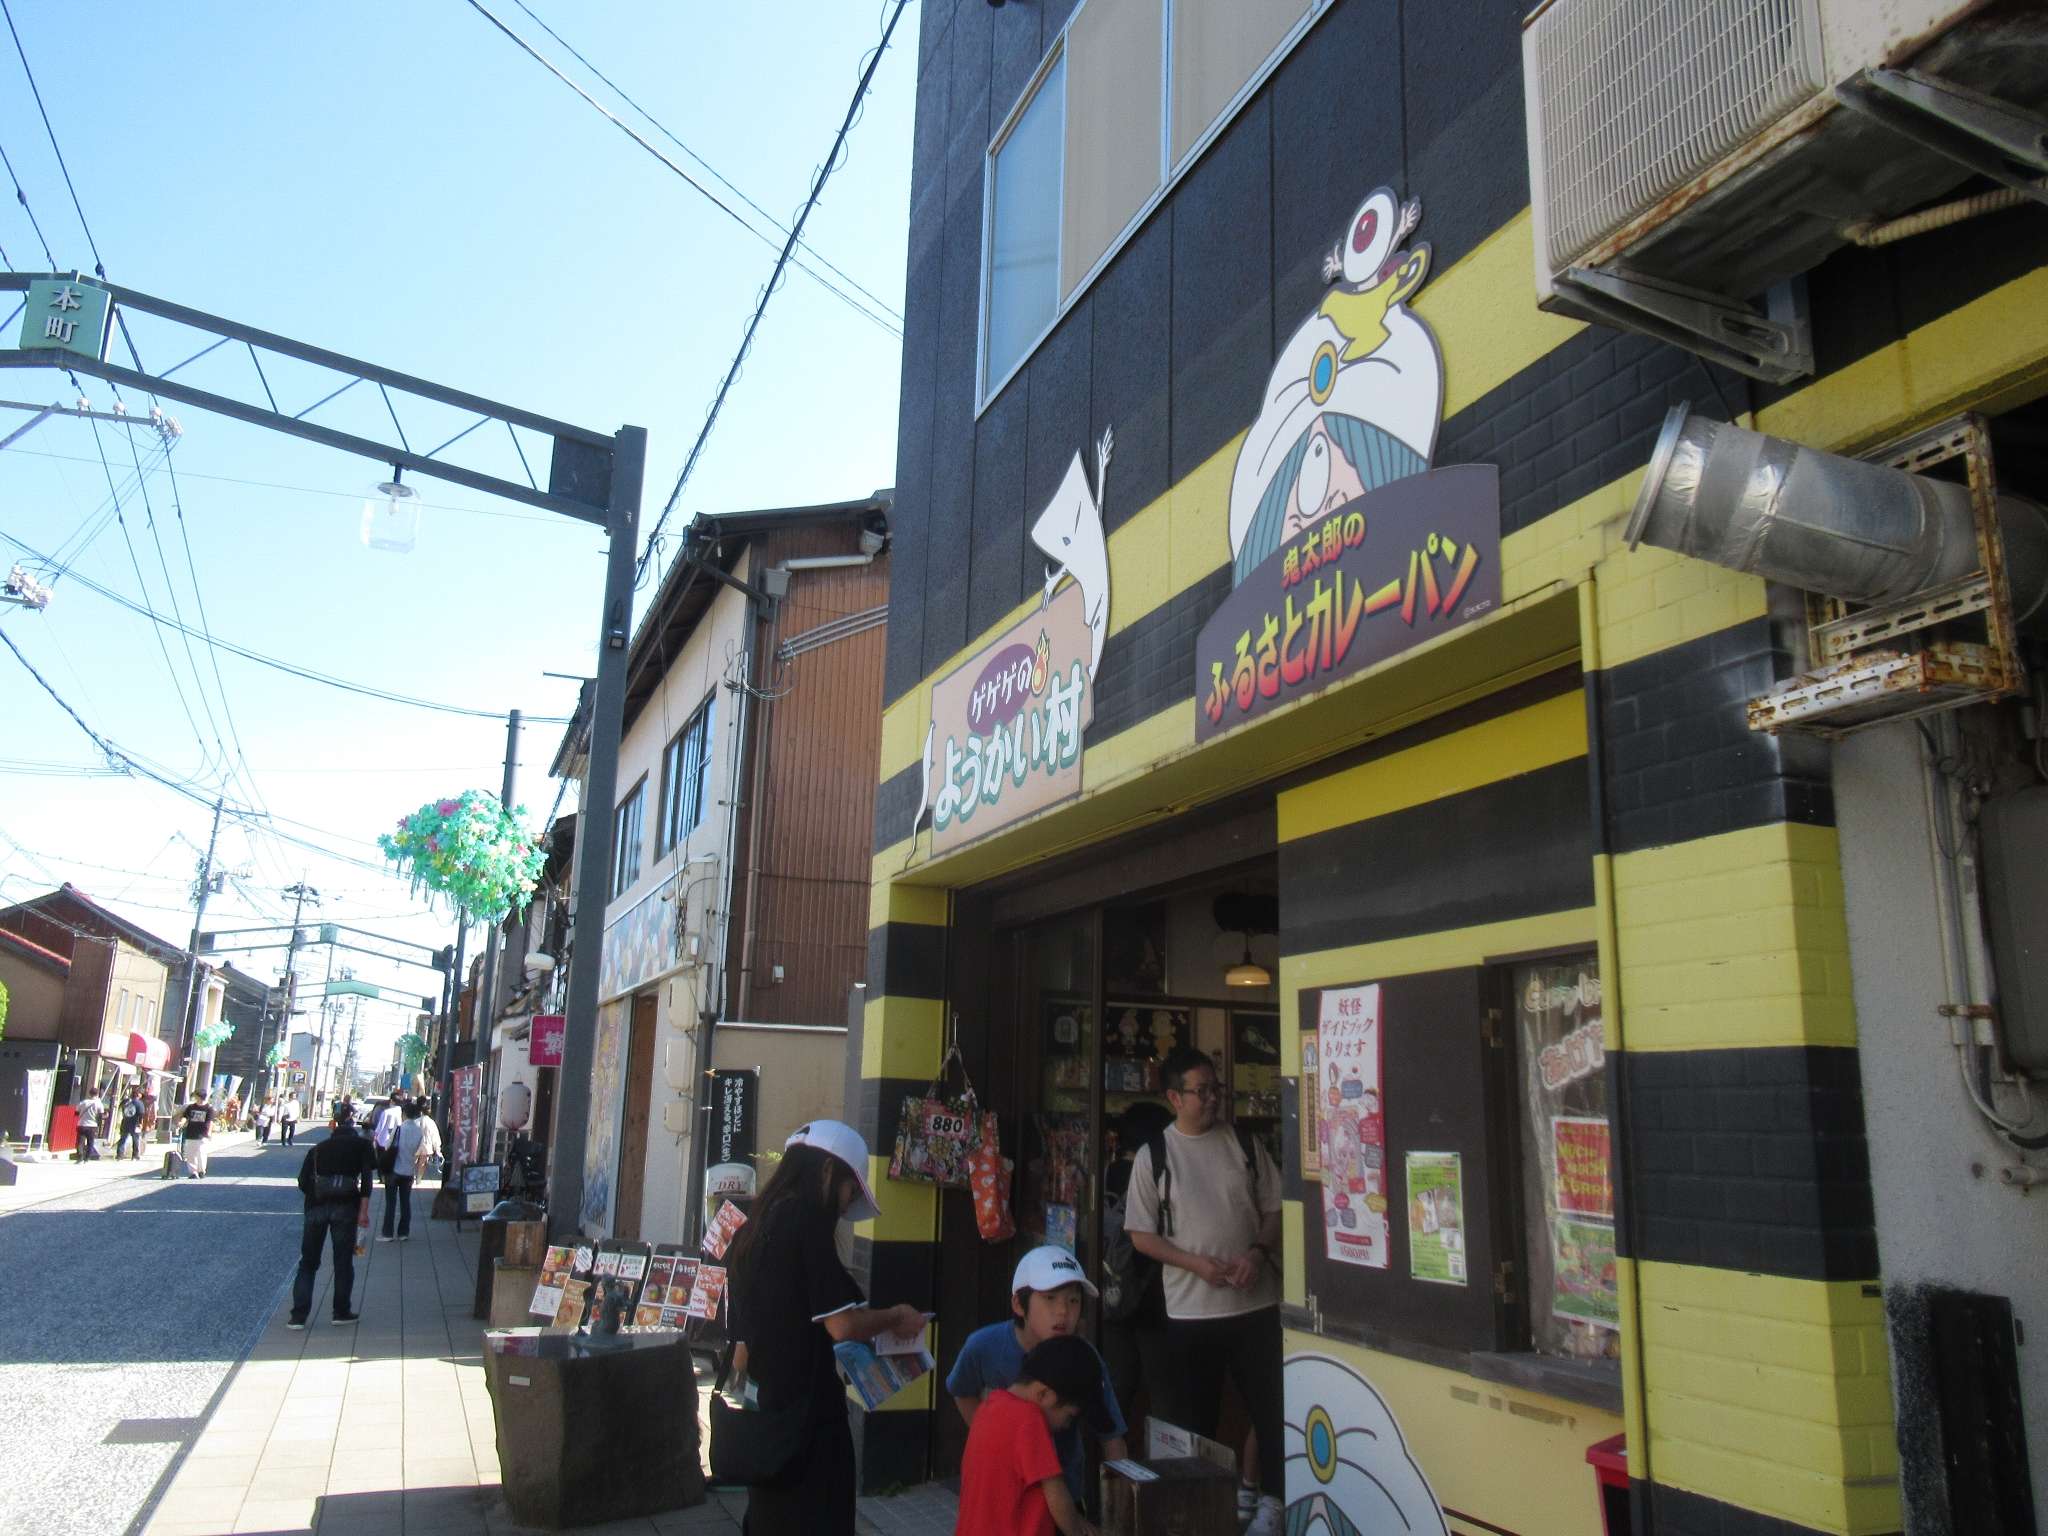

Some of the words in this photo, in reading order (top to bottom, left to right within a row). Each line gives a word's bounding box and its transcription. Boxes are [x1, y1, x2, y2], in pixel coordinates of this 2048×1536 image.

[45, 286, 83, 344] 本町
[1281, 512, 1367, 588] 鬼太郎の
[1204, 532, 1480, 724] ふるさとカレーパン
[971, 655, 1033, 723] ゲゲゲの
[934, 660, 1083, 830] ようかい村
[1337, 997, 1362, 1017] 妖怪
[1321, 1016, 1374, 1037] ガイドブック
[1324, 1038, 1367, 1059] あります
[295, 1072, 305, 1083] P
[931, 1116, 964, 1134] 880
[718, 1180, 744, 1191] DRY
